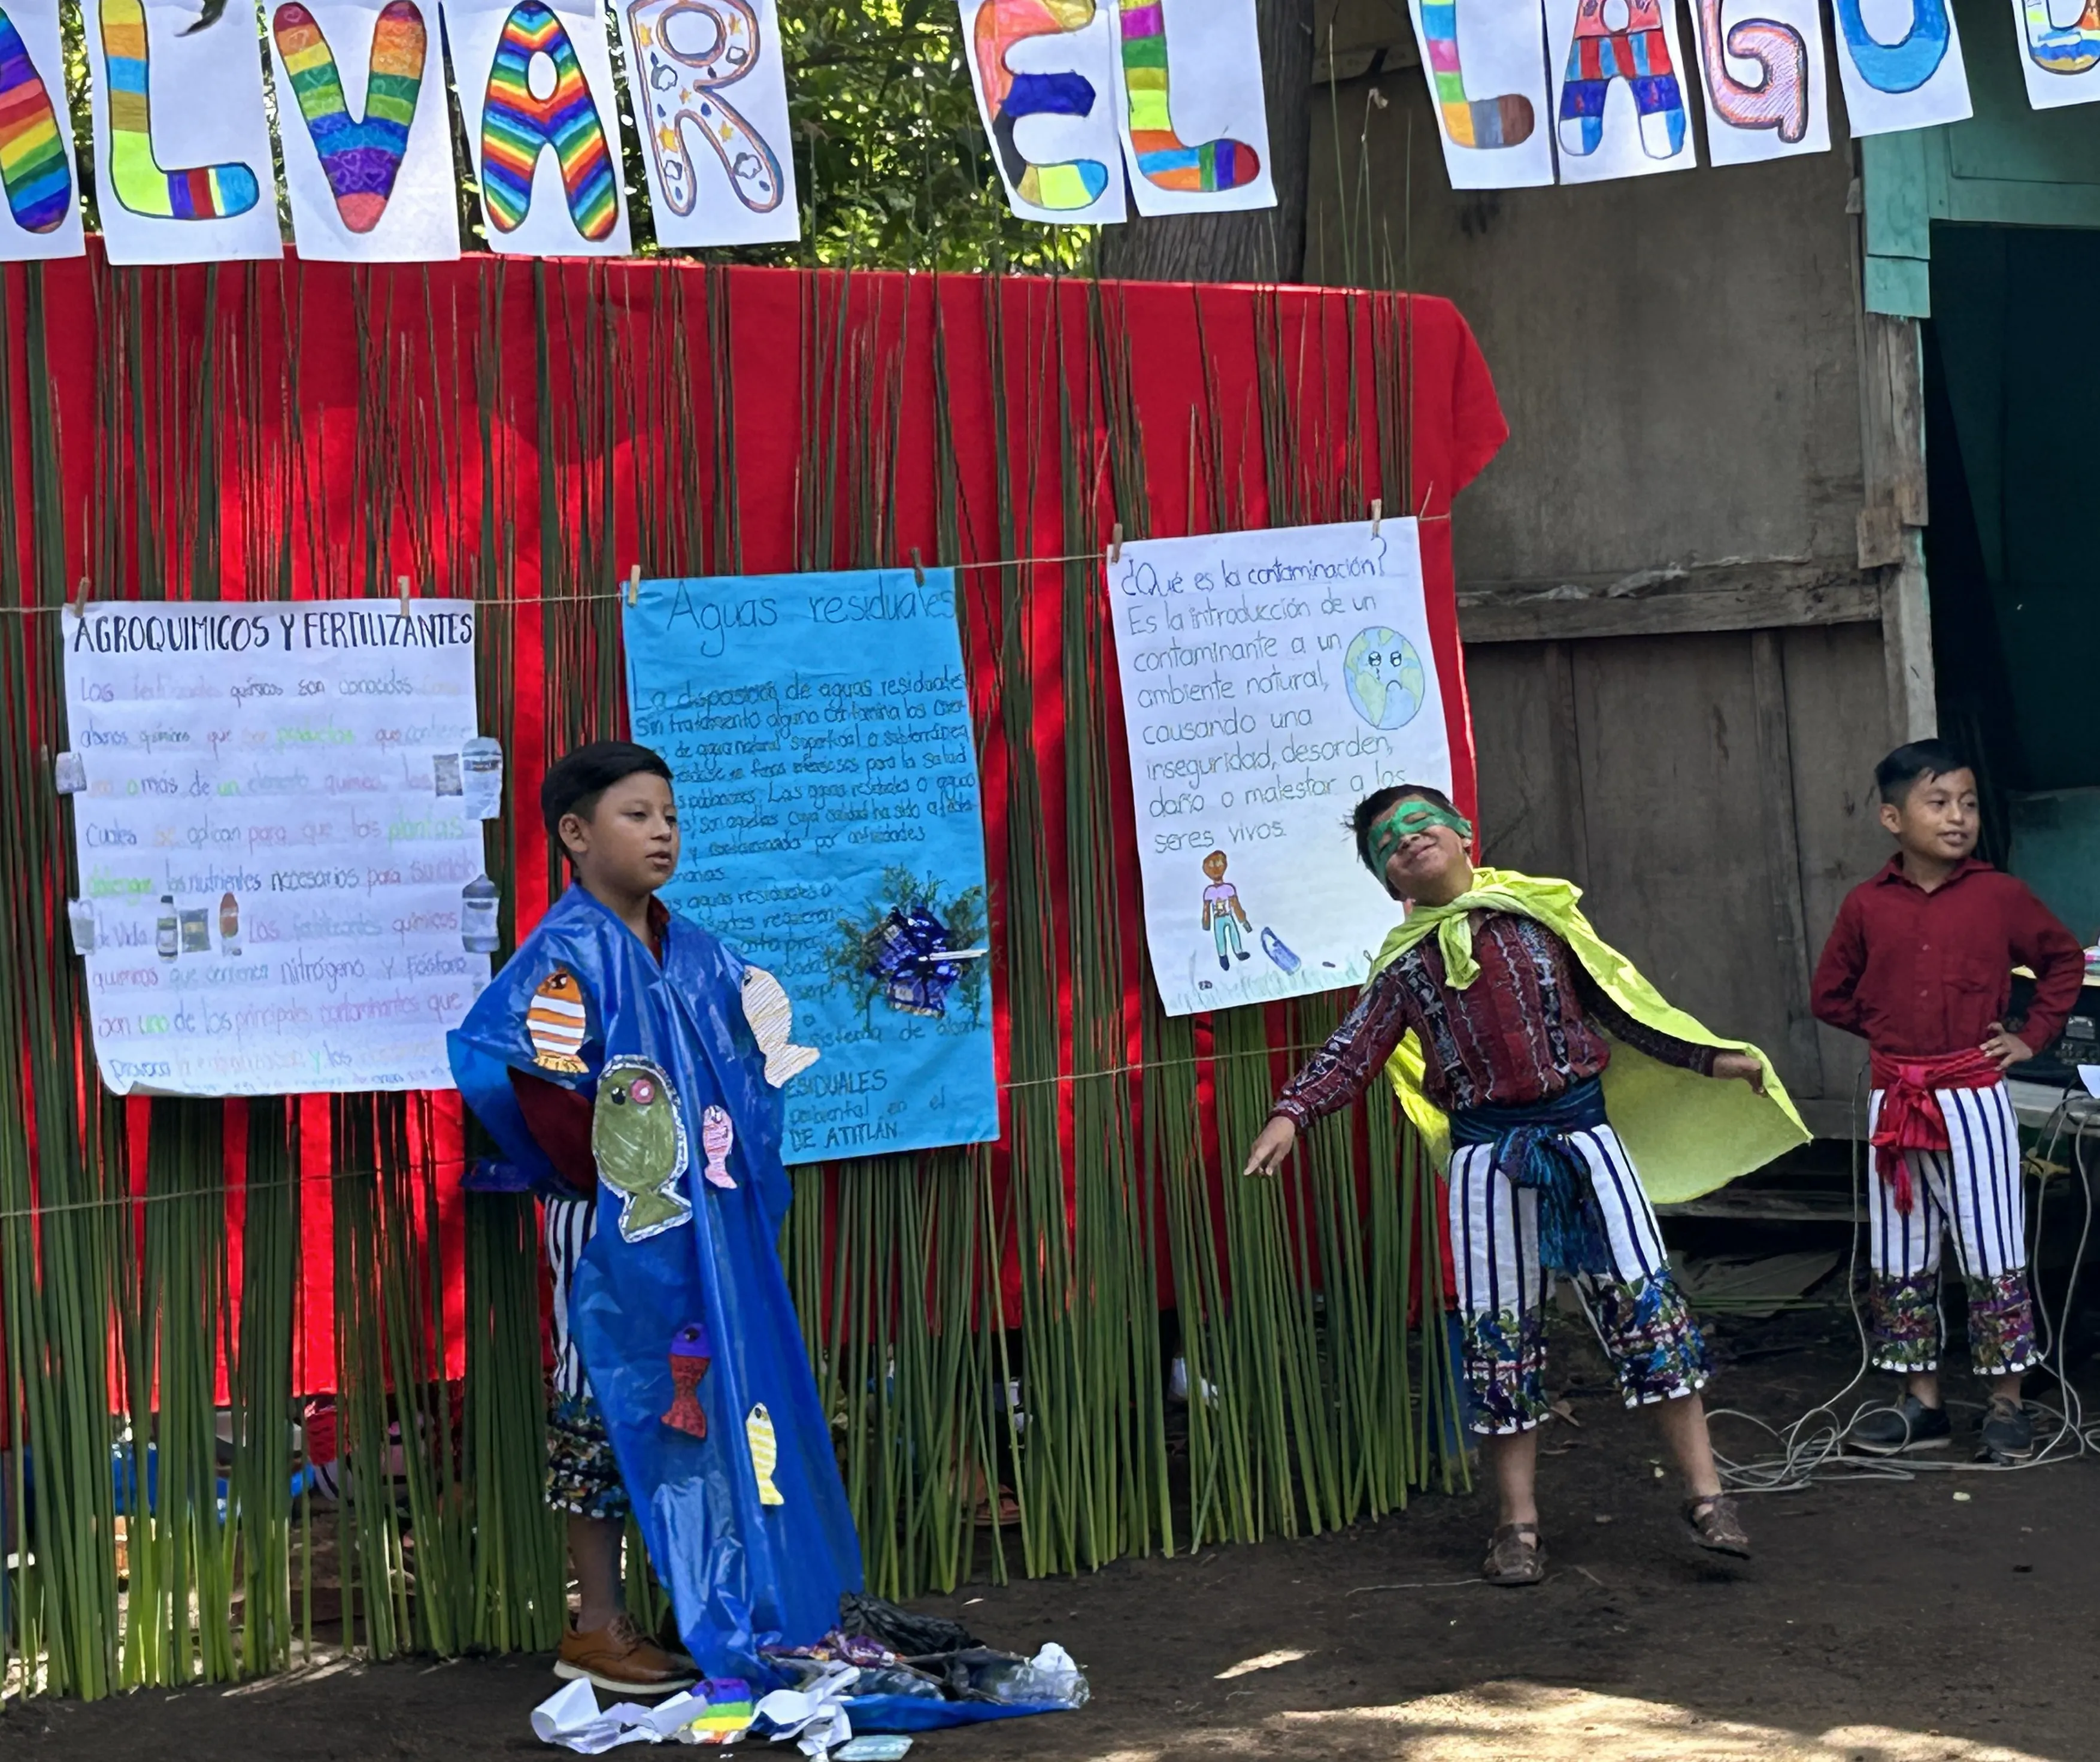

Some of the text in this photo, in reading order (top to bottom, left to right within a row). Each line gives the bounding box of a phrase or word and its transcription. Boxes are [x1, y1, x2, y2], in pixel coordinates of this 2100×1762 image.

[974, 0, 1260, 211] EL
[1195, 571, 1215, 592] es
[1222, 559, 1241, 588] la
[666, 570, 956, 658] Aguas residuales
[1128, 605, 1157, 635] Es
[1164, 600, 1185, 632] la
[1321, 586, 1343, 615] de
[1354, 594, 1377, 611] un
[74, 614, 270, 653] AGROQUIMICOS
[280, 613, 295, 651] Y
[1134, 630, 1343, 673] contaminante a un
[786, 671, 812, 700] de
[1137, 670, 1236, 709] ambiente
[1142, 707, 1313, 746] causando una
[1149, 782, 1205, 819] daño
[1221, 790, 1235, 809] o
[1245, 766, 1336, 804] malestar
[1350, 773, 1364, 793] a
[1154, 828, 1215, 854] seres
[785, 1069, 888, 1100] ESIDUALES
